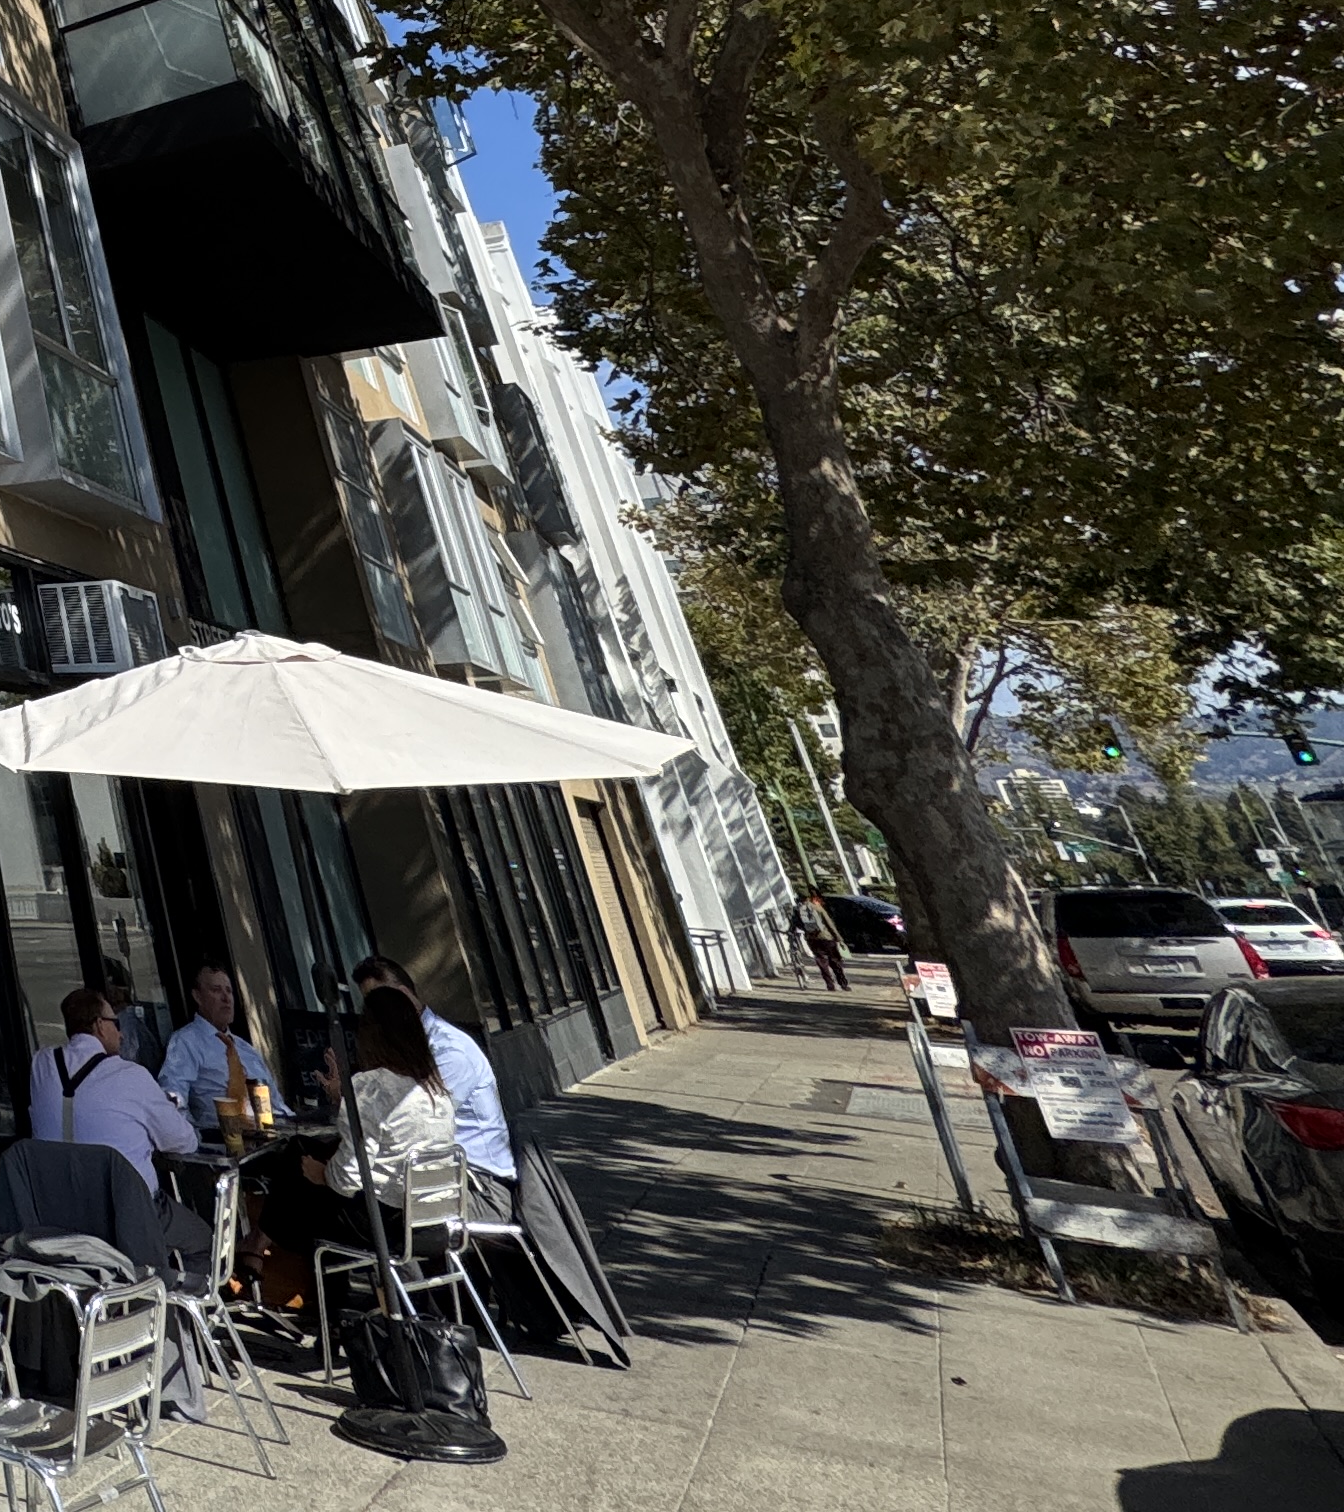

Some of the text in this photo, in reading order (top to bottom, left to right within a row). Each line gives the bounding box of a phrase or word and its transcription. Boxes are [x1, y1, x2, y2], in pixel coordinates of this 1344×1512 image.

[1014, 1031, 1096, 1045] TOW-AWAY
[1023, 1044, 1102, 1061] NO PARKING
